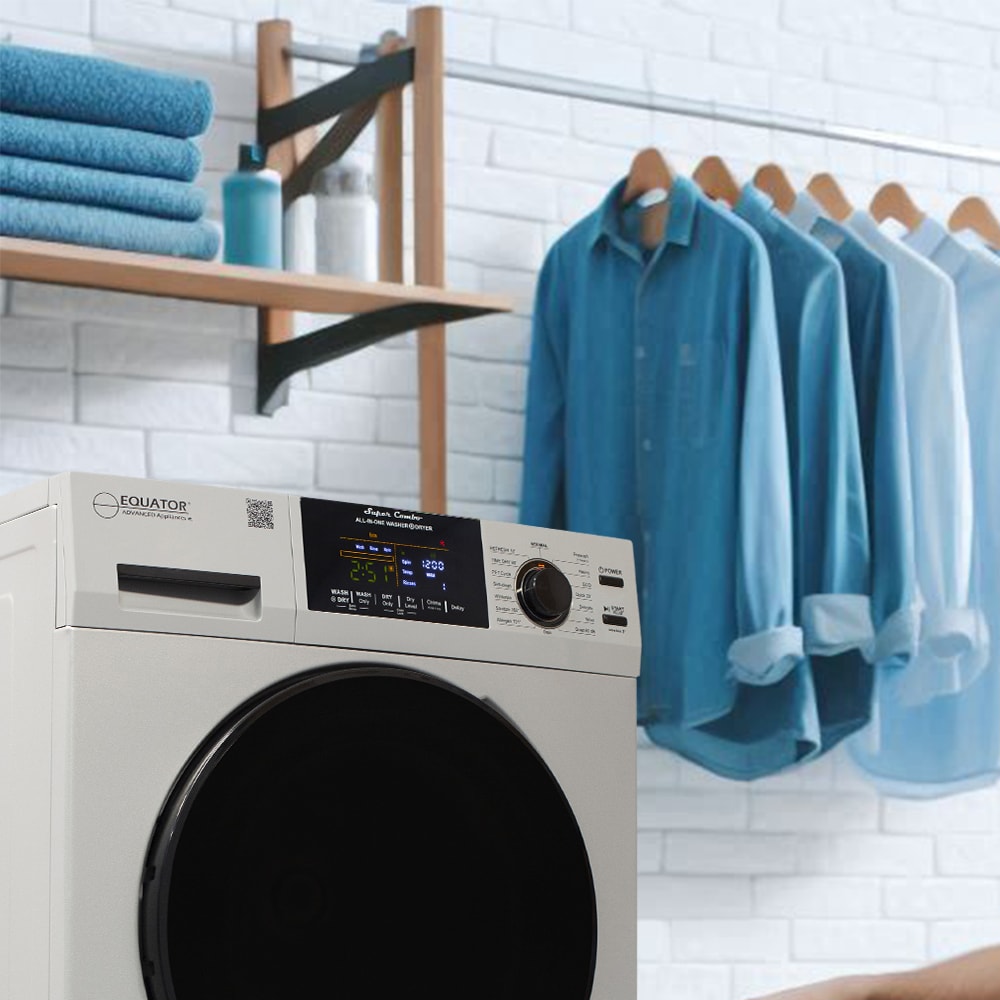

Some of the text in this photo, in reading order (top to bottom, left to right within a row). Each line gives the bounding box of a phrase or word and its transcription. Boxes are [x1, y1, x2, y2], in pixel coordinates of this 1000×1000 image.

[121, 495, 187, 512] EQUATOR
[364, 508, 423, 521] Super Combo
[422, 559, 445, 571] 1200
[349, 559, 389, 584] 2:51
[604, 568, 623, 576] POWER
[330, 588, 350, 596] WASH
[336, 596, 350, 604] DRY
[358, 598, 370, 606] Only
[382, 600, 394, 608] Only
